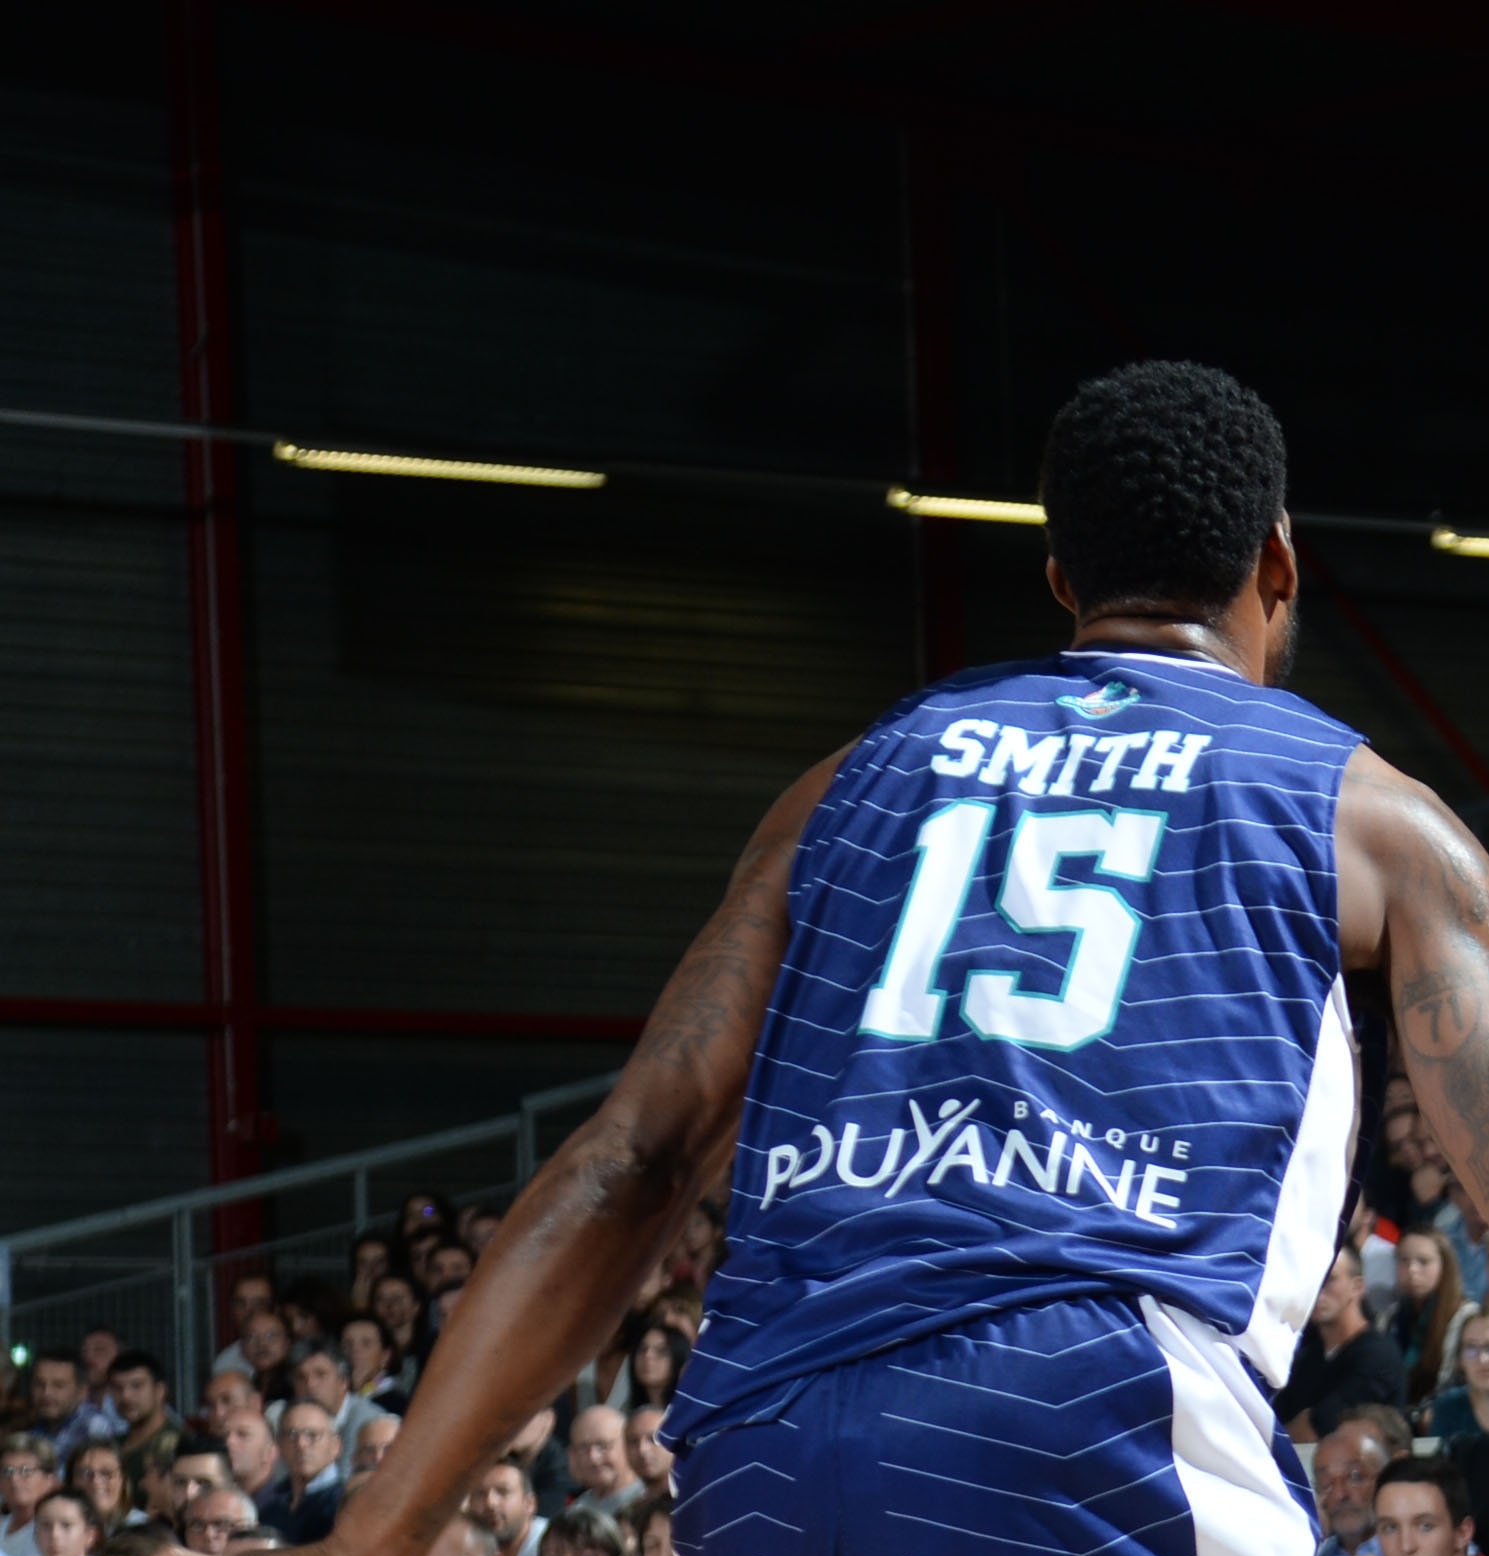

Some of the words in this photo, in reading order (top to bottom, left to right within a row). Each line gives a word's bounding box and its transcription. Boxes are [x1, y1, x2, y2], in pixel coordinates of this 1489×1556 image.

[930, 719, 1212, 793] SMITH
[857, 799, 1168, 1052] 15
[760, 1099, 1188, 1229] POUYANNE
[1014, 1100, 1192, 1160] BANQUE
